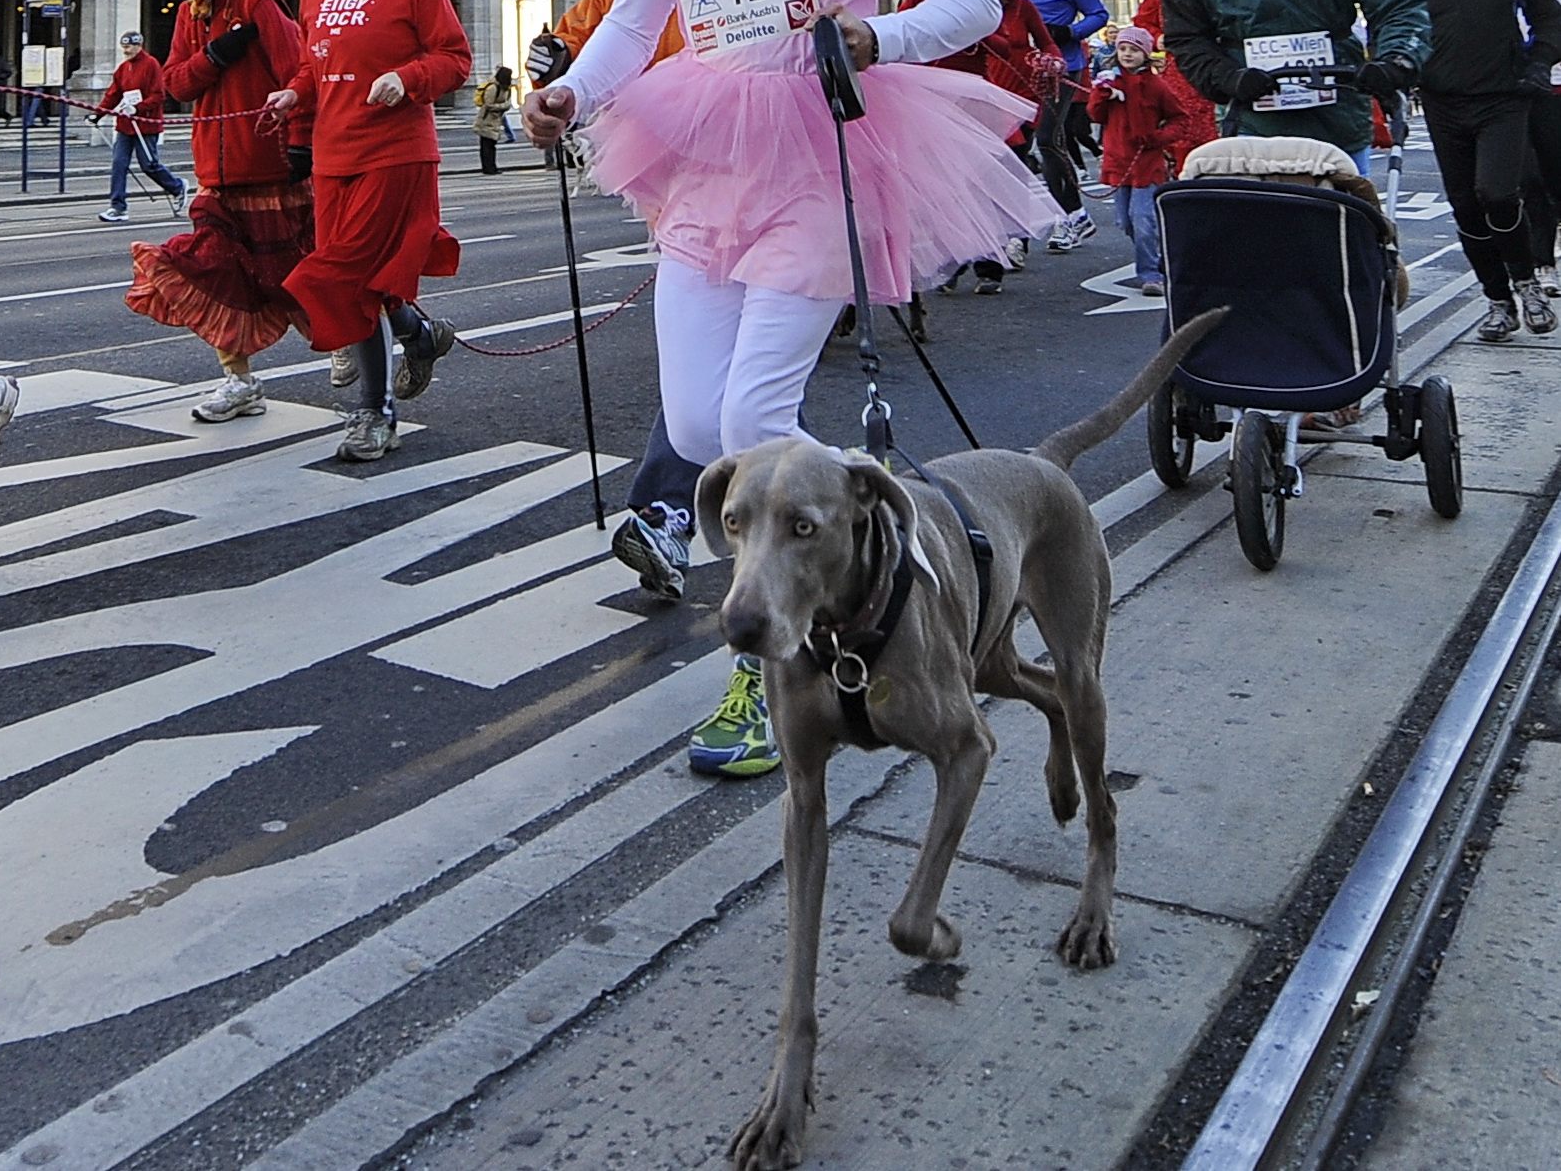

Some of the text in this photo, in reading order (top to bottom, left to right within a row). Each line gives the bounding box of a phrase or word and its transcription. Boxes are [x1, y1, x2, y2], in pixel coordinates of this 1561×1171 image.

[726, 5, 781, 25] Bank Austria
[1250, 36, 1327, 55] LCC-Wien
